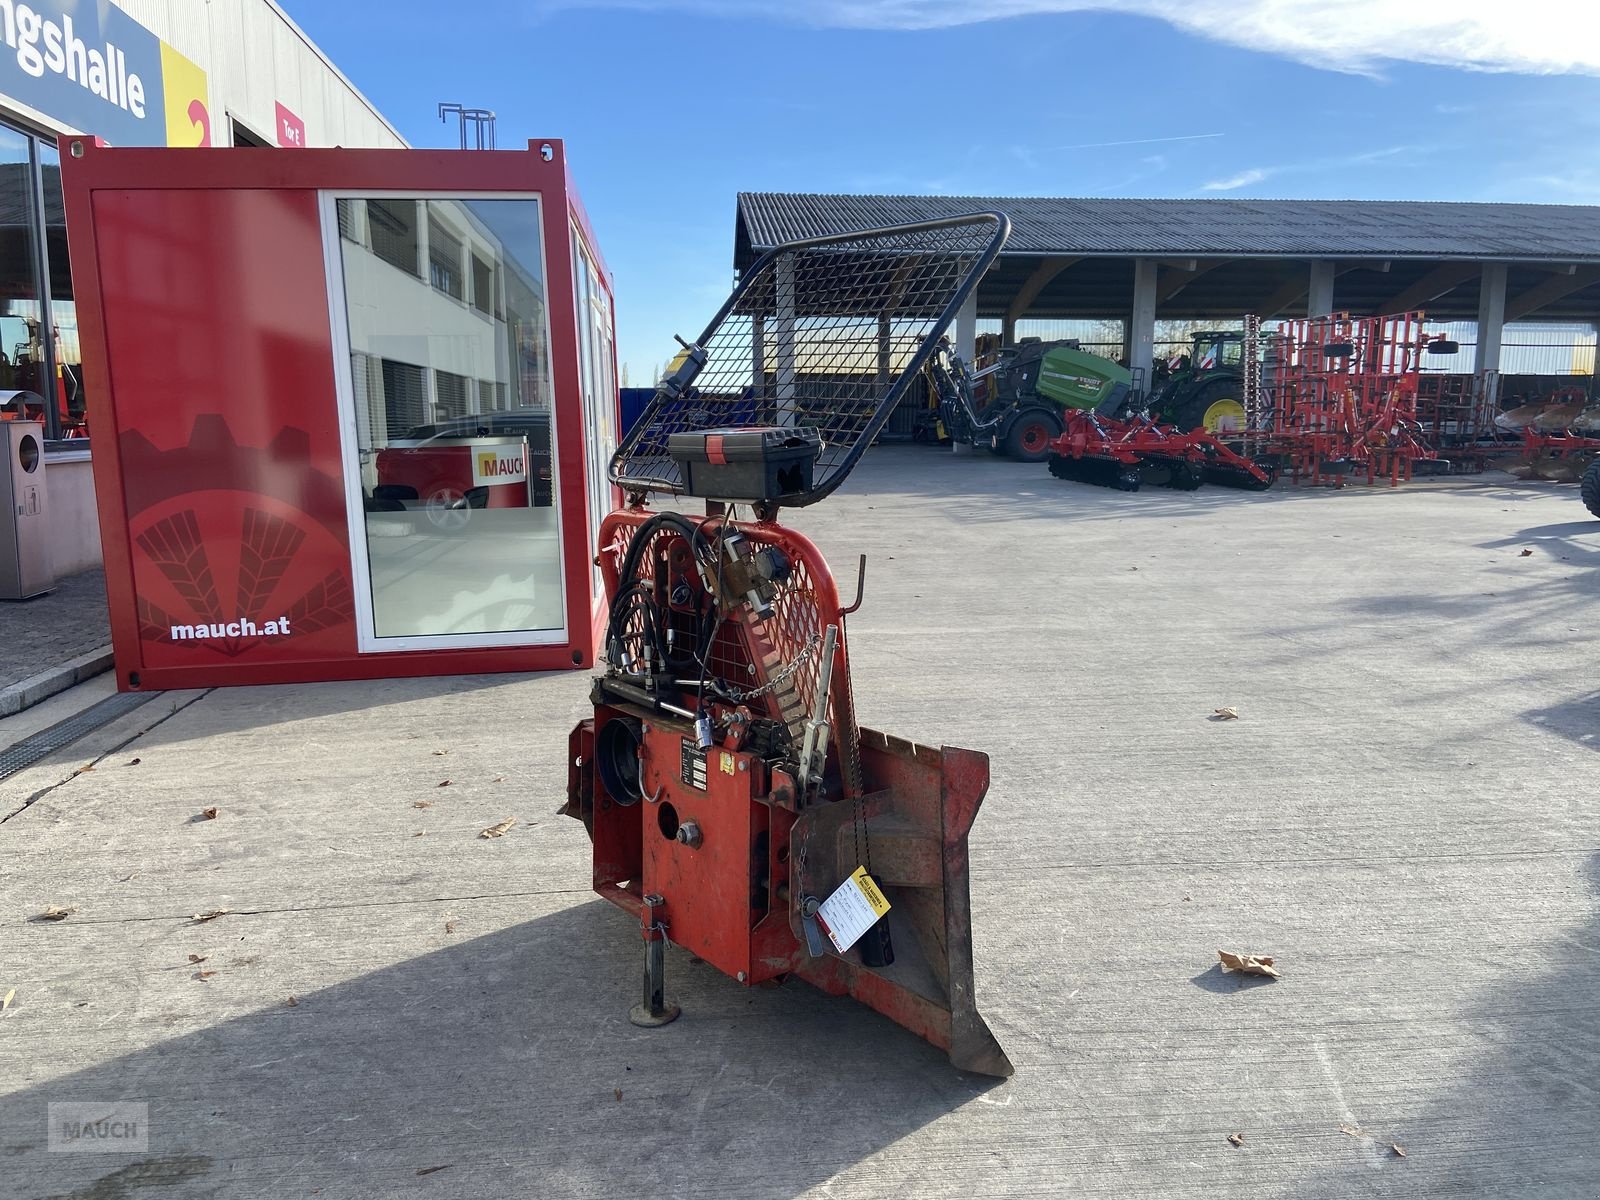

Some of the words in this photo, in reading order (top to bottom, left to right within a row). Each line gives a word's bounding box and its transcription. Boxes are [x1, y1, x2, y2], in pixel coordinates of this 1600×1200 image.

[0, 0, 146, 119] ngshalle
[283, 119, 294, 142] Tor
[295, 127, 300, 146] E
[484, 457, 523, 476] MAUCH
[171, 616, 290, 640] mauch.at
